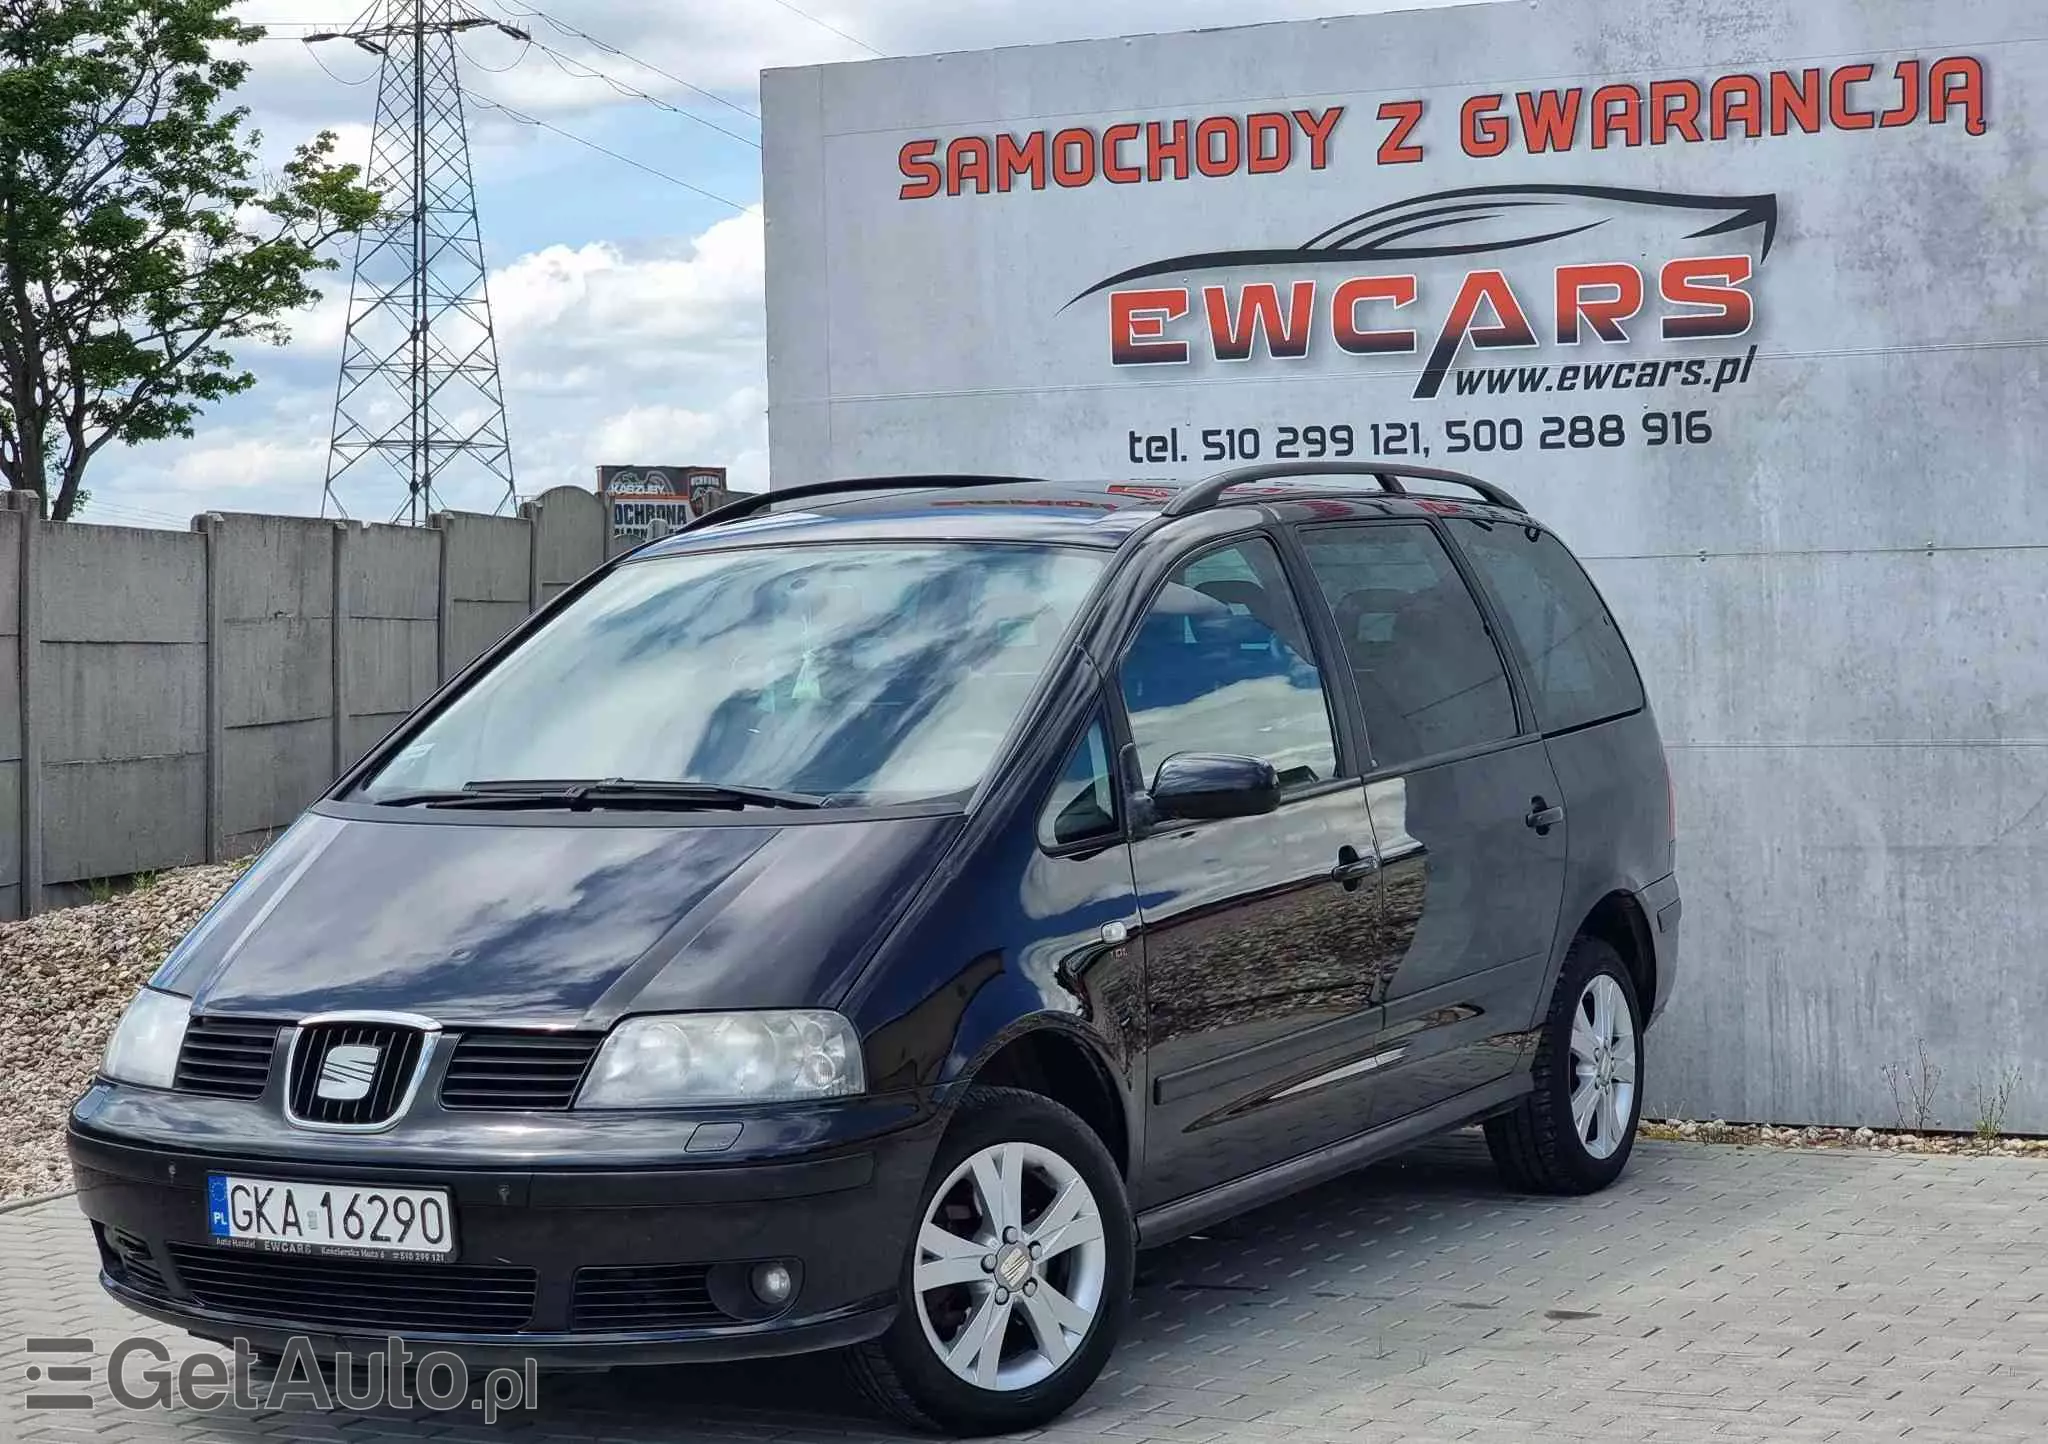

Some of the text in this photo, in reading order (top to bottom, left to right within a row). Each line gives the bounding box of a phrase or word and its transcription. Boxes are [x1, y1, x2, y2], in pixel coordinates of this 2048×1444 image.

[899, 55, 1987, 201] SAMOCHODY Z GWARANCJĄ
[1109, 255, 1754, 401] EWCARS
[1456, 344, 1759, 396] www.ewcars.pl
[1129, 410, 1712, 464] tel. 510 299 121, 500 288 916
[614, 503, 687, 525] OCHRONA
[213, 1212, 228, 1225] PL
[230, 1184, 445, 1244] GKA 16290
[264, 1240, 312, 1255] EWCARS
